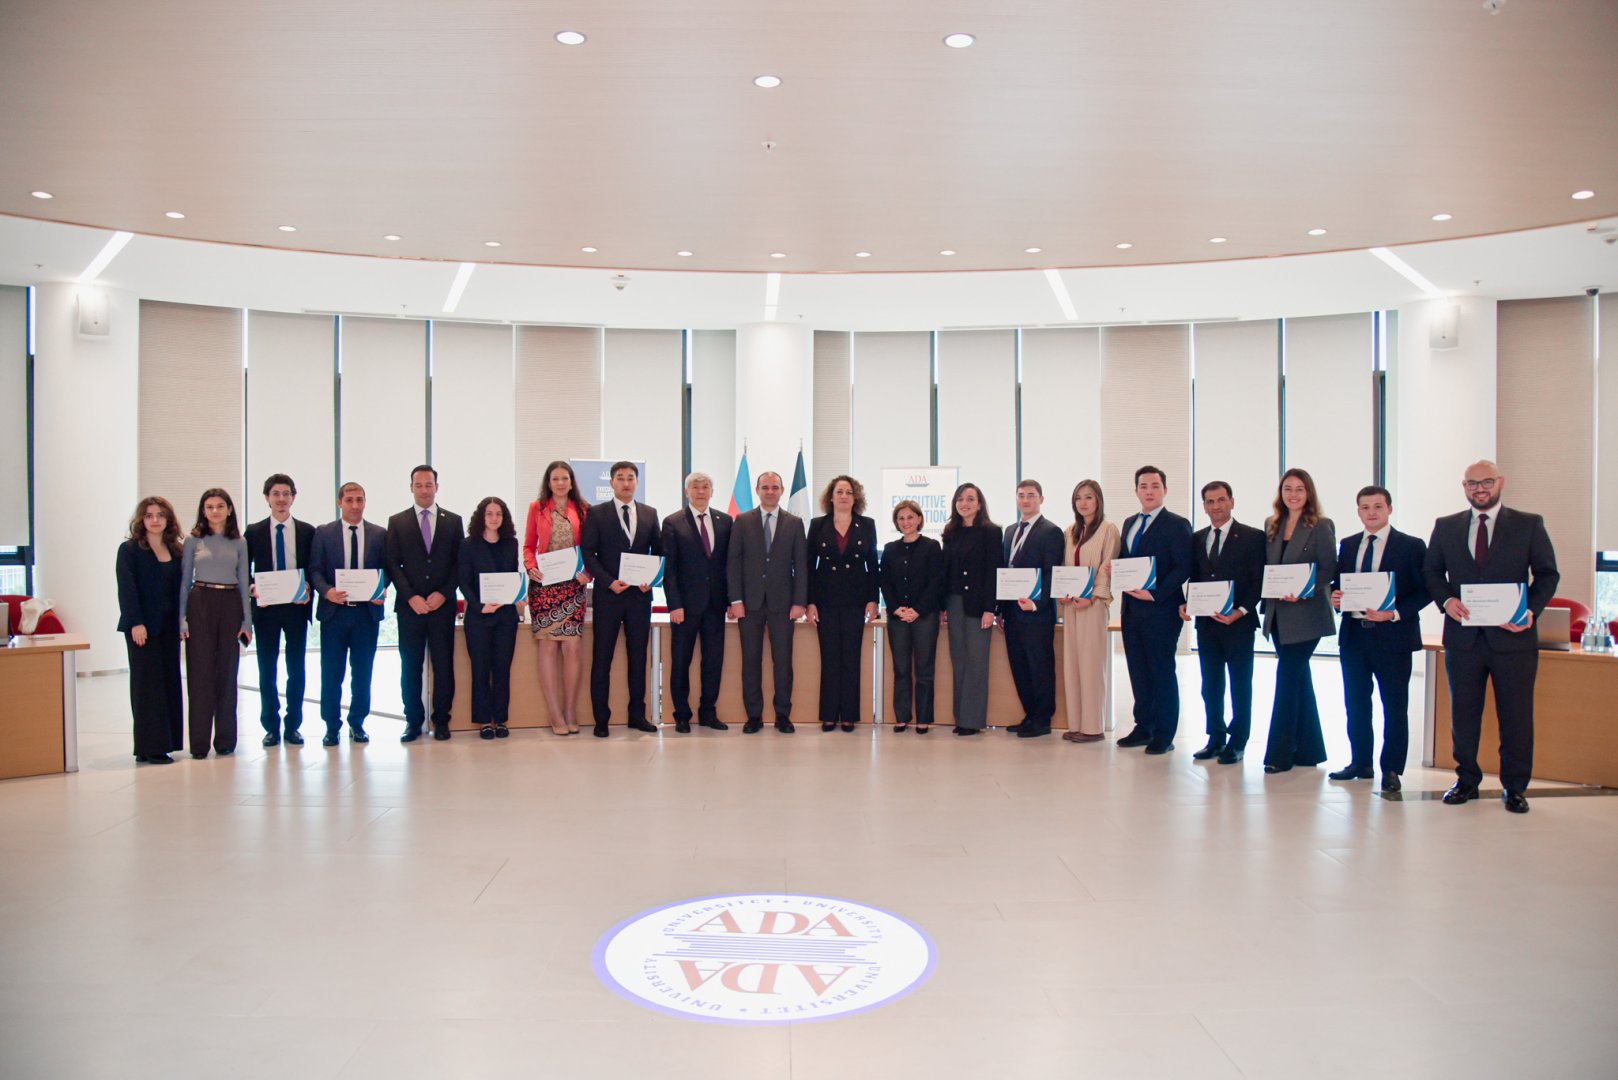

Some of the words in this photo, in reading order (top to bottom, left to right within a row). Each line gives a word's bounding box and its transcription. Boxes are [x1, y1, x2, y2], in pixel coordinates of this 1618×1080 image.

[909, 475, 927, 483] ADA
[688, 909, 857, 937] ADA
[803, 900, 882, 939] UNIVERSITY
[643, 958, 722, 1012] UNIVERSITY
[674, 959, 857, 997] ADA
